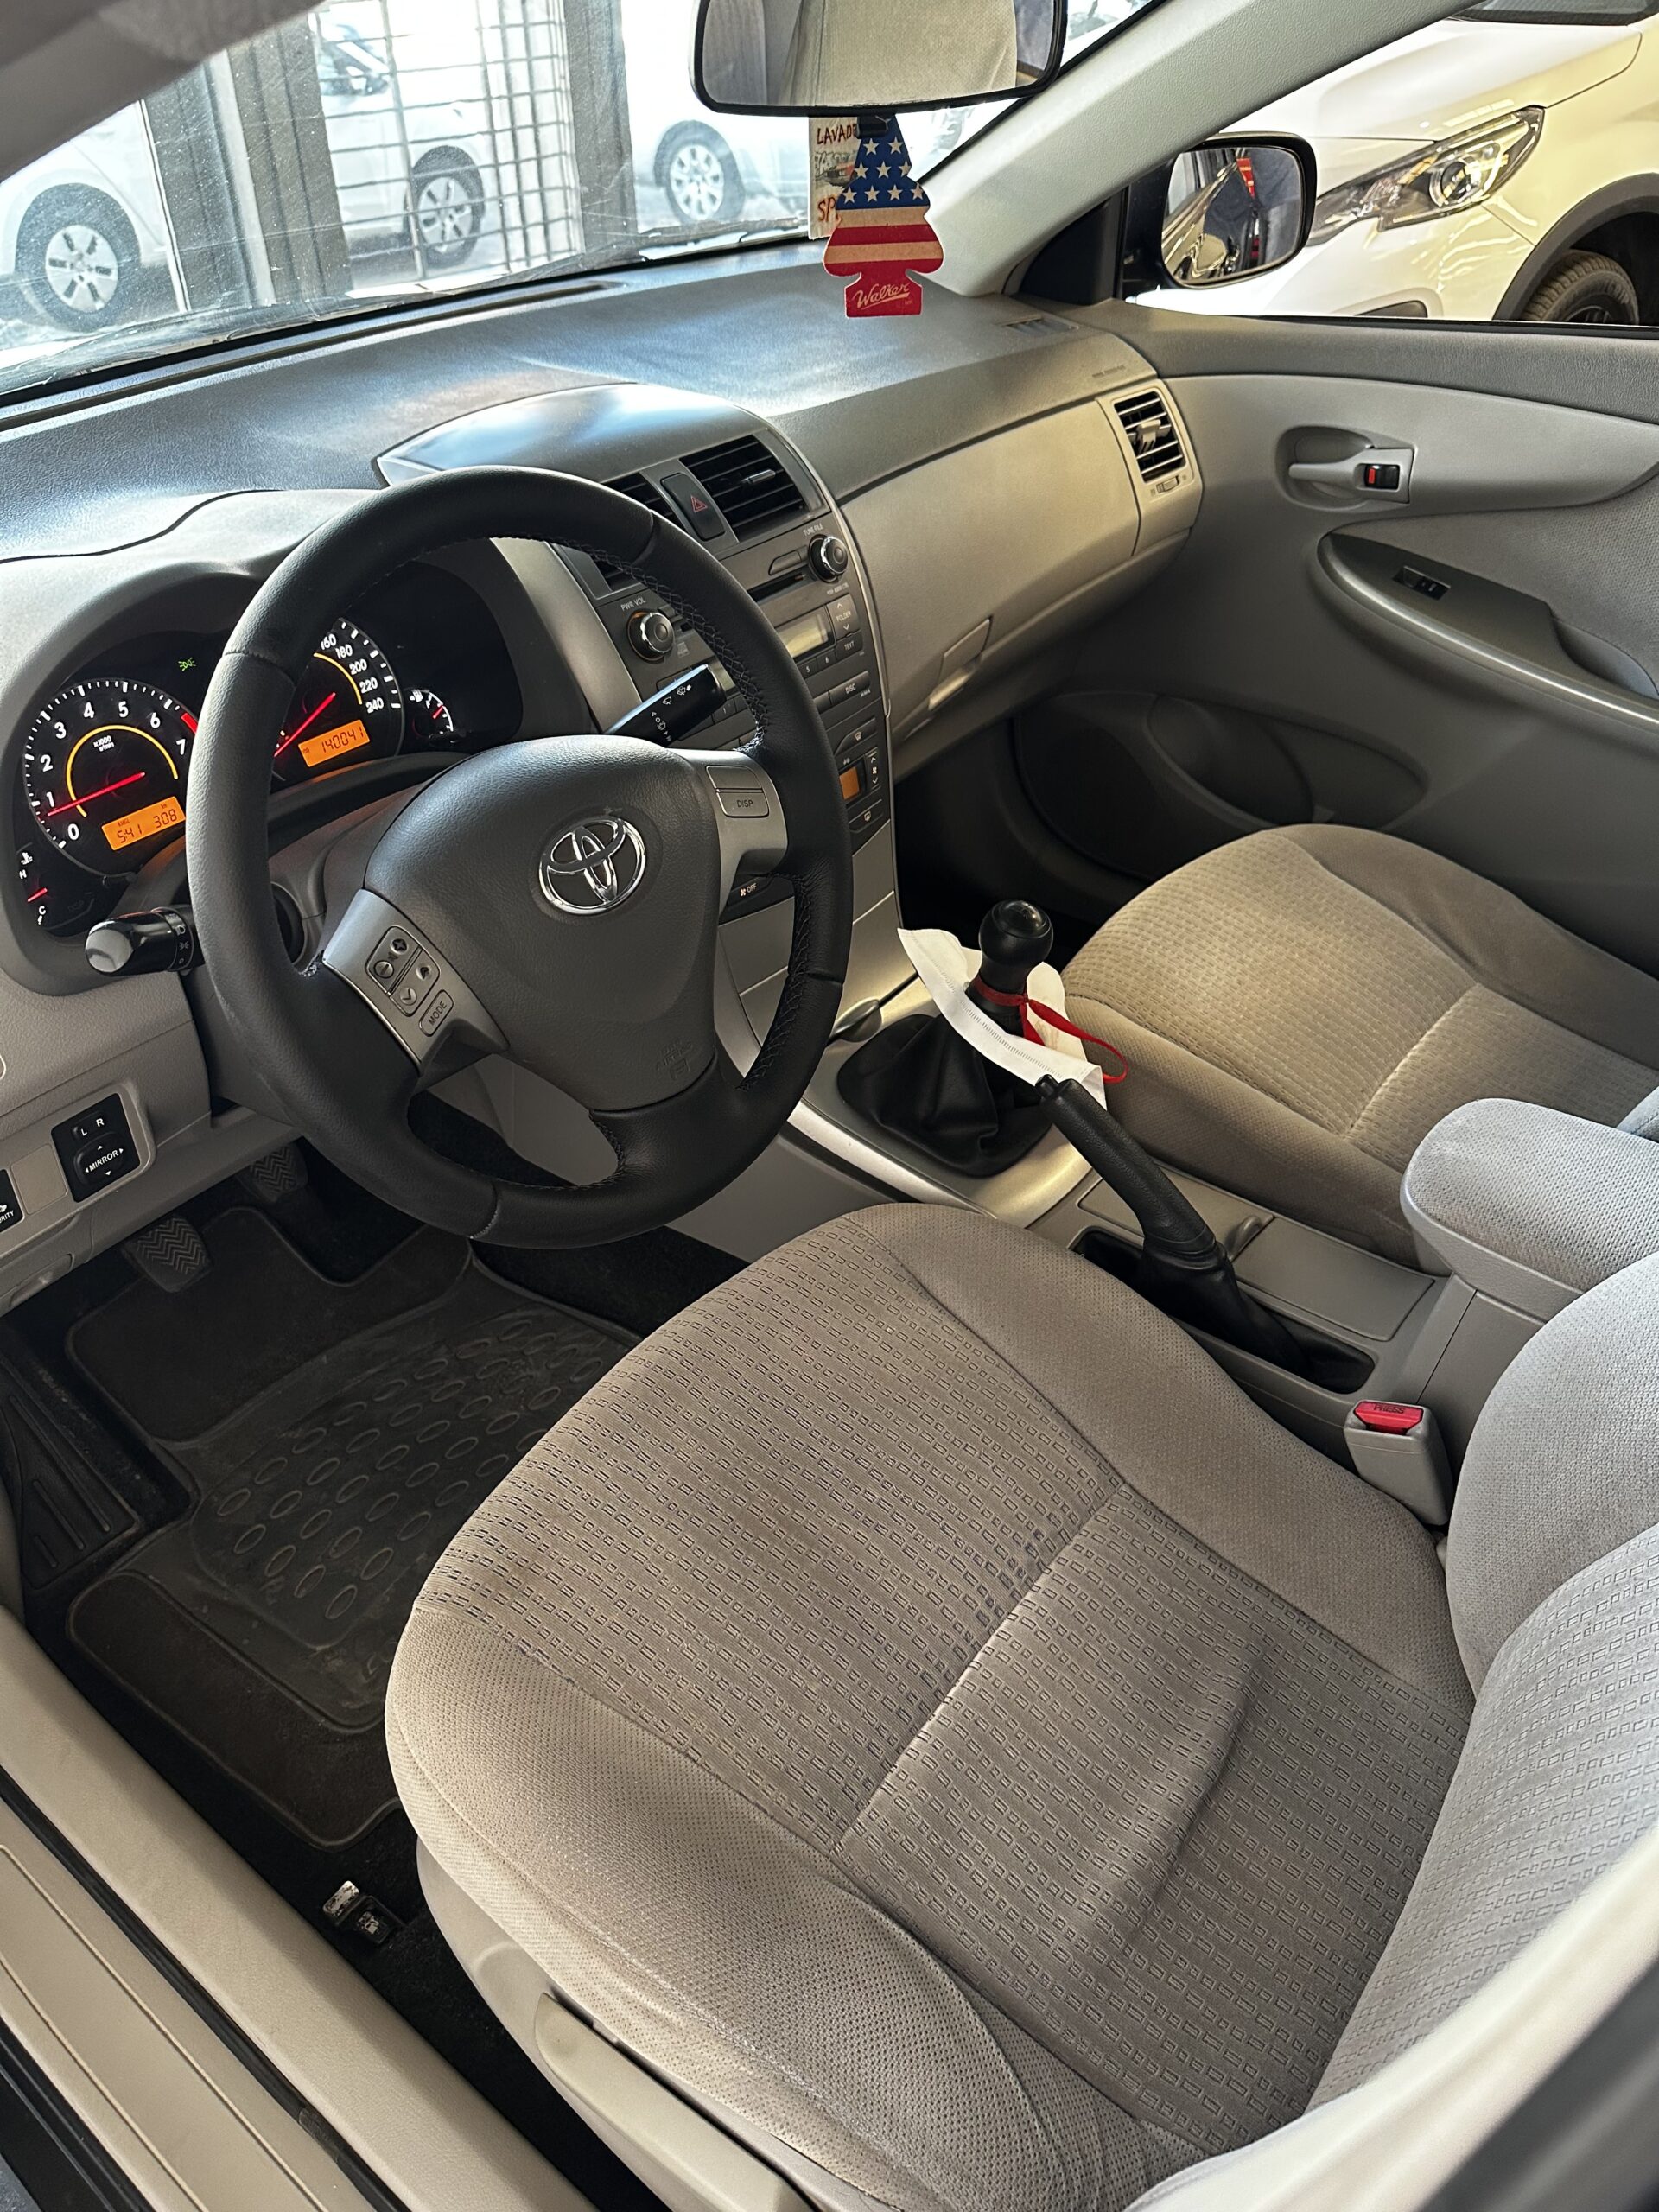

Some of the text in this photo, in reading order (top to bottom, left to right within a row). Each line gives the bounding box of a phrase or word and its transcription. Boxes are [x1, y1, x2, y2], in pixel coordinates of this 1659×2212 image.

[817, 196, 839, 222] SP
[852, 282, 910, 308] Walker
[620, 597, 646, 612] PWR VOL
[836, 610, 852, 622] FOLDER
[335, 644, 353, 659] 180
[349, 658, 368, 675] 200
[359, 677, 378, 694] 220
[83, 702, 95, 719] 4
[118, 701, 129, 718] 5
[365, 696, 385, 714] 240
[149, 712, 161, 728] 6
[54, 721, 67, 739] 3
[176, 738, 186, 756] 7
[321, 726, 365, 753] 140041
[40, 754, 54, 772] 2
[46, 791, 55, 807] 1
[736, 799, 753, 809] DISP
[153, 809, 178, 829] 308
[67, 823, 79, 841] 0
[19, 869, 28, 880] H
[747, 882, 757, 893] OFF
[38, 905, 47, 915] C
[428, 1000, 448, 1027] MODE
[96, 1117, 105, 1128] R
[88, 1149, 119, 1173] MIRROR
[0, 1210, 14, 1224] RITY
[1373, 1403, 1405, 1414] PRESS
